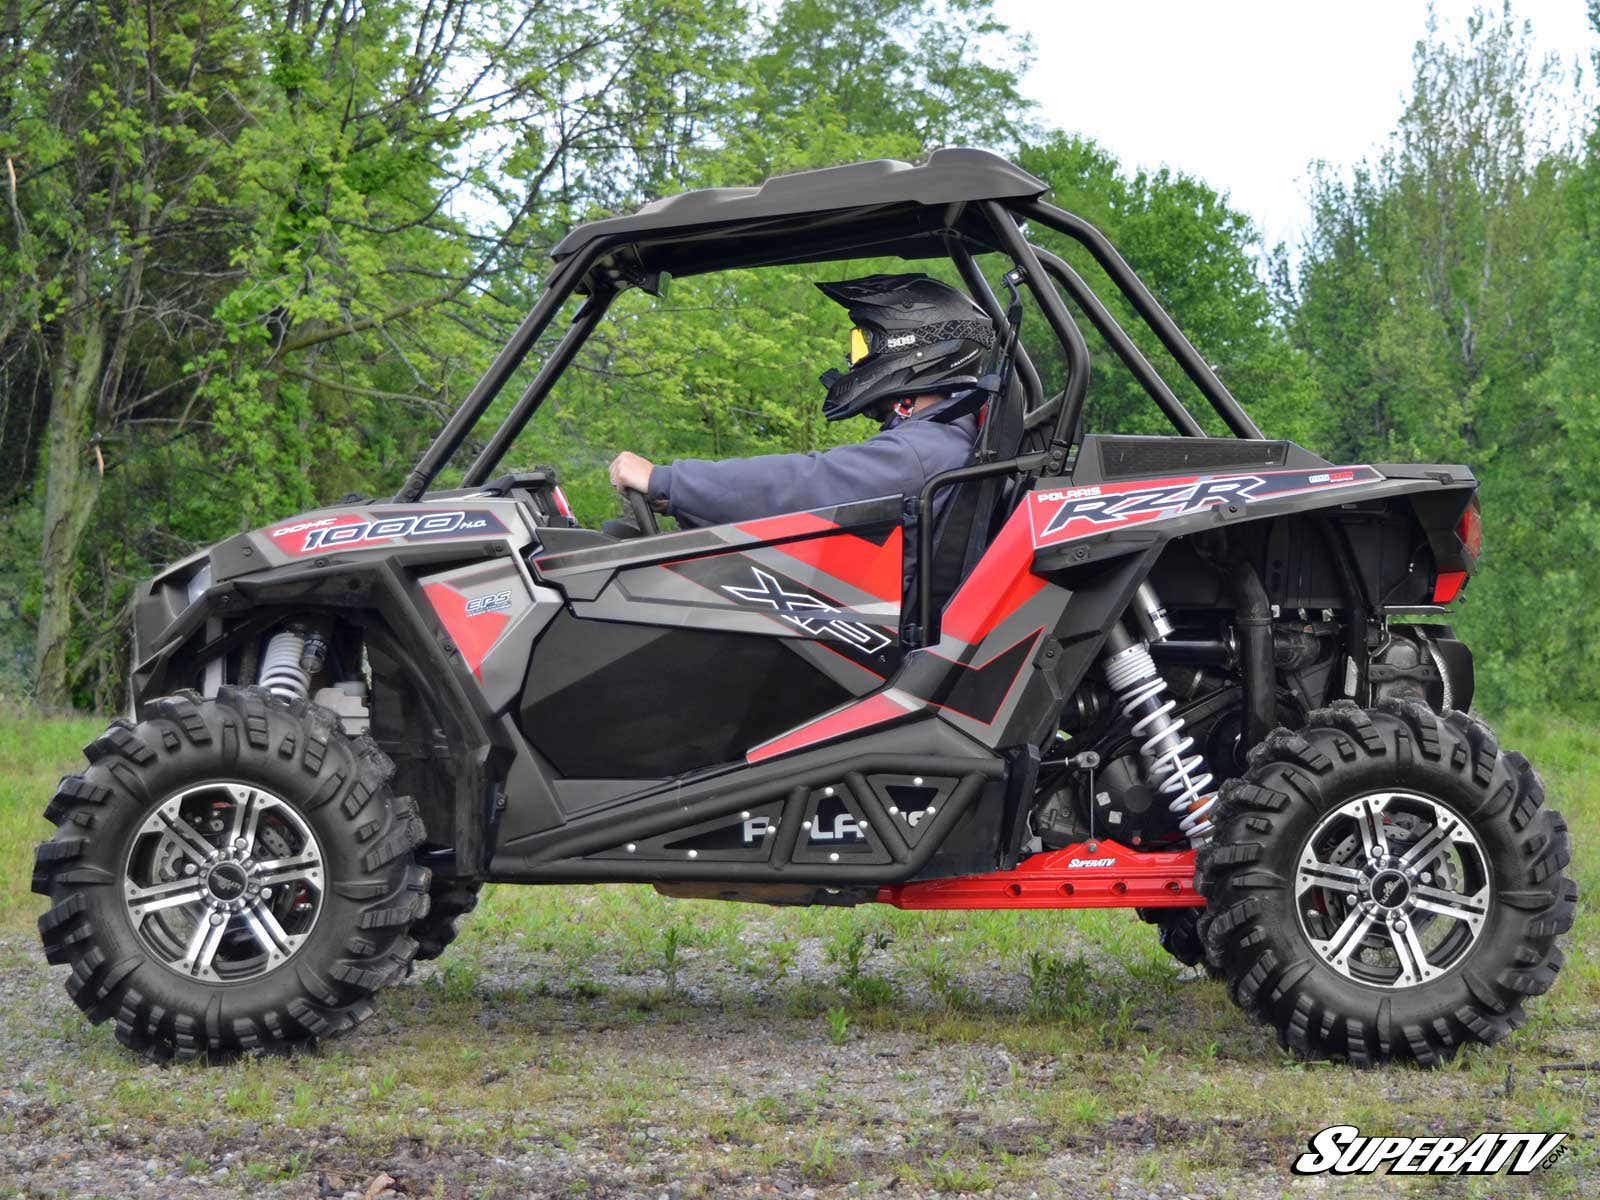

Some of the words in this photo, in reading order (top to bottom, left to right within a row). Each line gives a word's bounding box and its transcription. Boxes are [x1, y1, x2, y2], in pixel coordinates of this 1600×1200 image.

[1037, 486, 1101, 503] POLARIS
[1040, 476, 1266, 538] RZR
[301, 511, 465, 552] 1000
[465, 590, 511, 612] EPS
